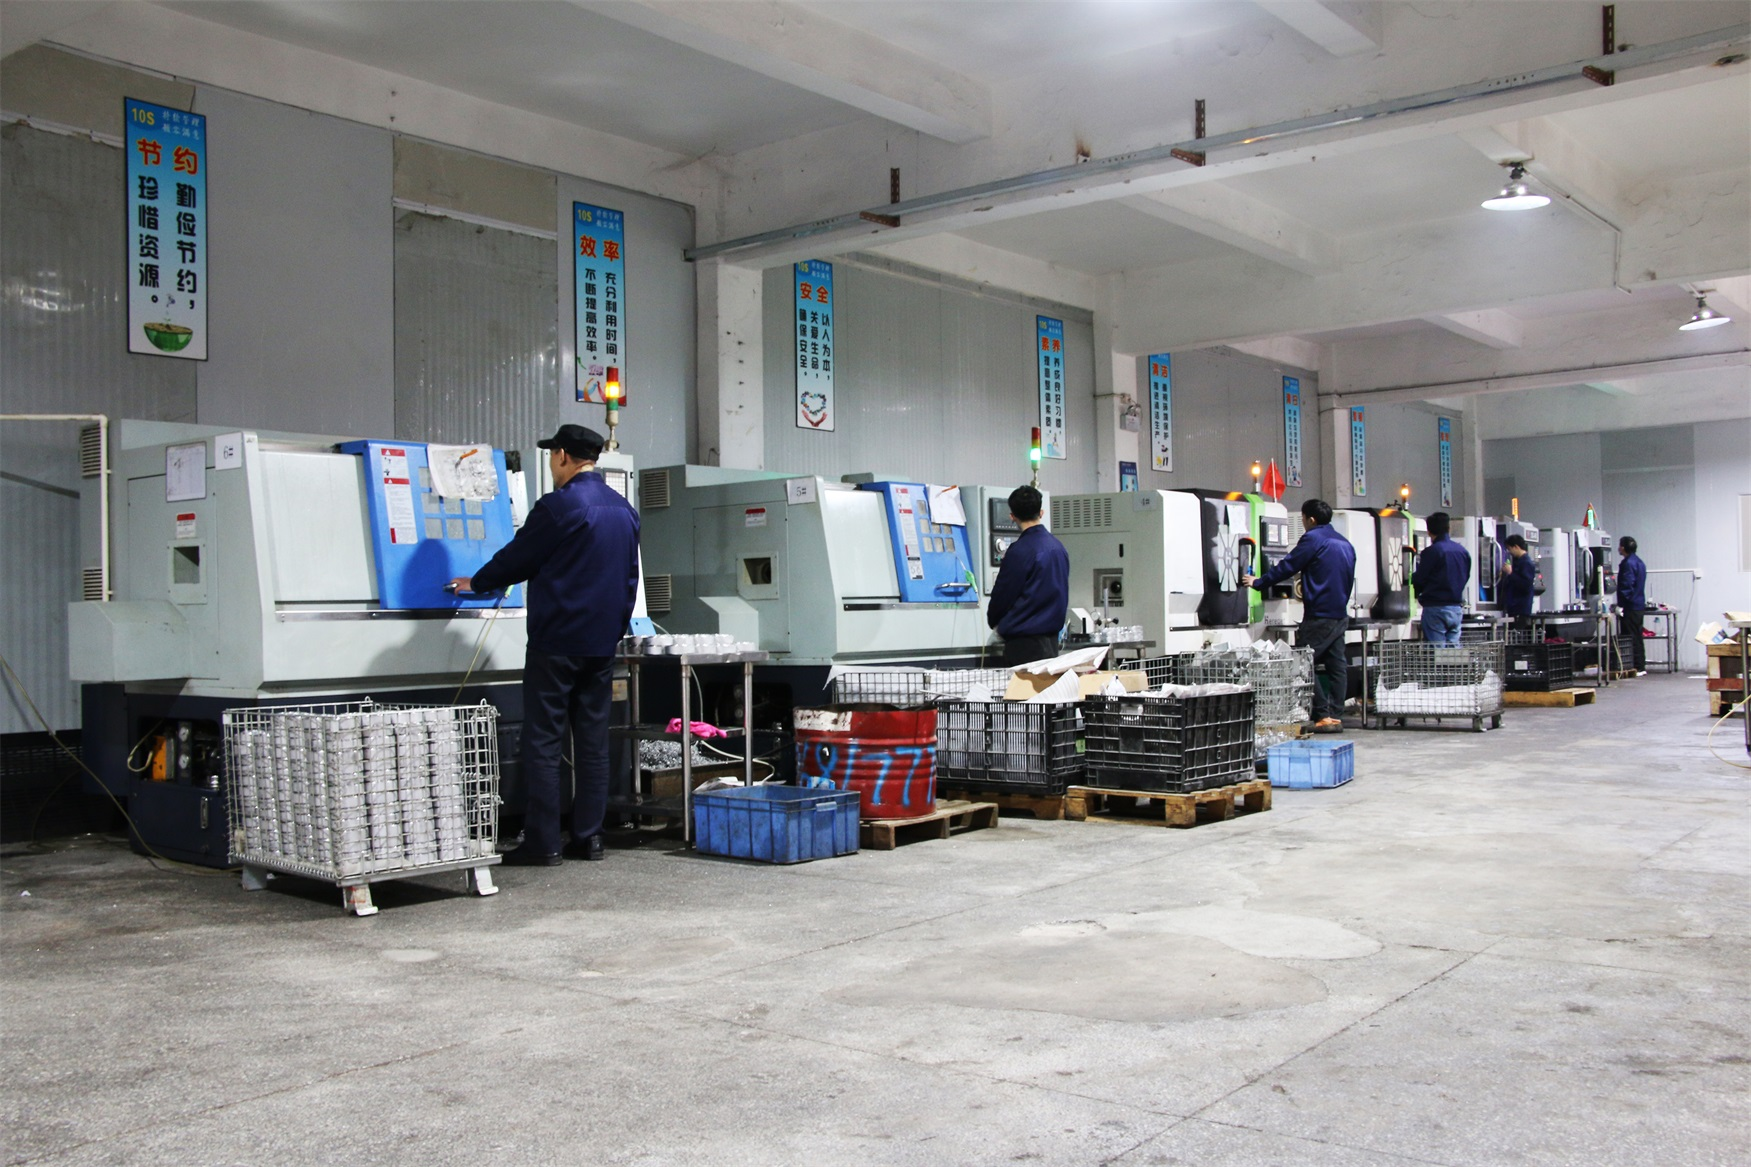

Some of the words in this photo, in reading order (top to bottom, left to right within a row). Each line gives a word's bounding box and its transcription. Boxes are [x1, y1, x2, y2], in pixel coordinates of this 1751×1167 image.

[132, 107, 156, 126] 10S
[137, 138, 199, 175] 节约
[138, 175, 159, 303] 珍惜资源。
[578, 209, 592, 222] 10S
[176, 182, 197, 309] 勤俭节约，
[580, 234, 620, 262] 效率
[585, 267, 597, 361] 不断提高效率。
[605, 272, 618, 363] 充分利用时间，
[800, 281, 829, 304] 安全
[822, 312, 831, 381] 以人为本，
